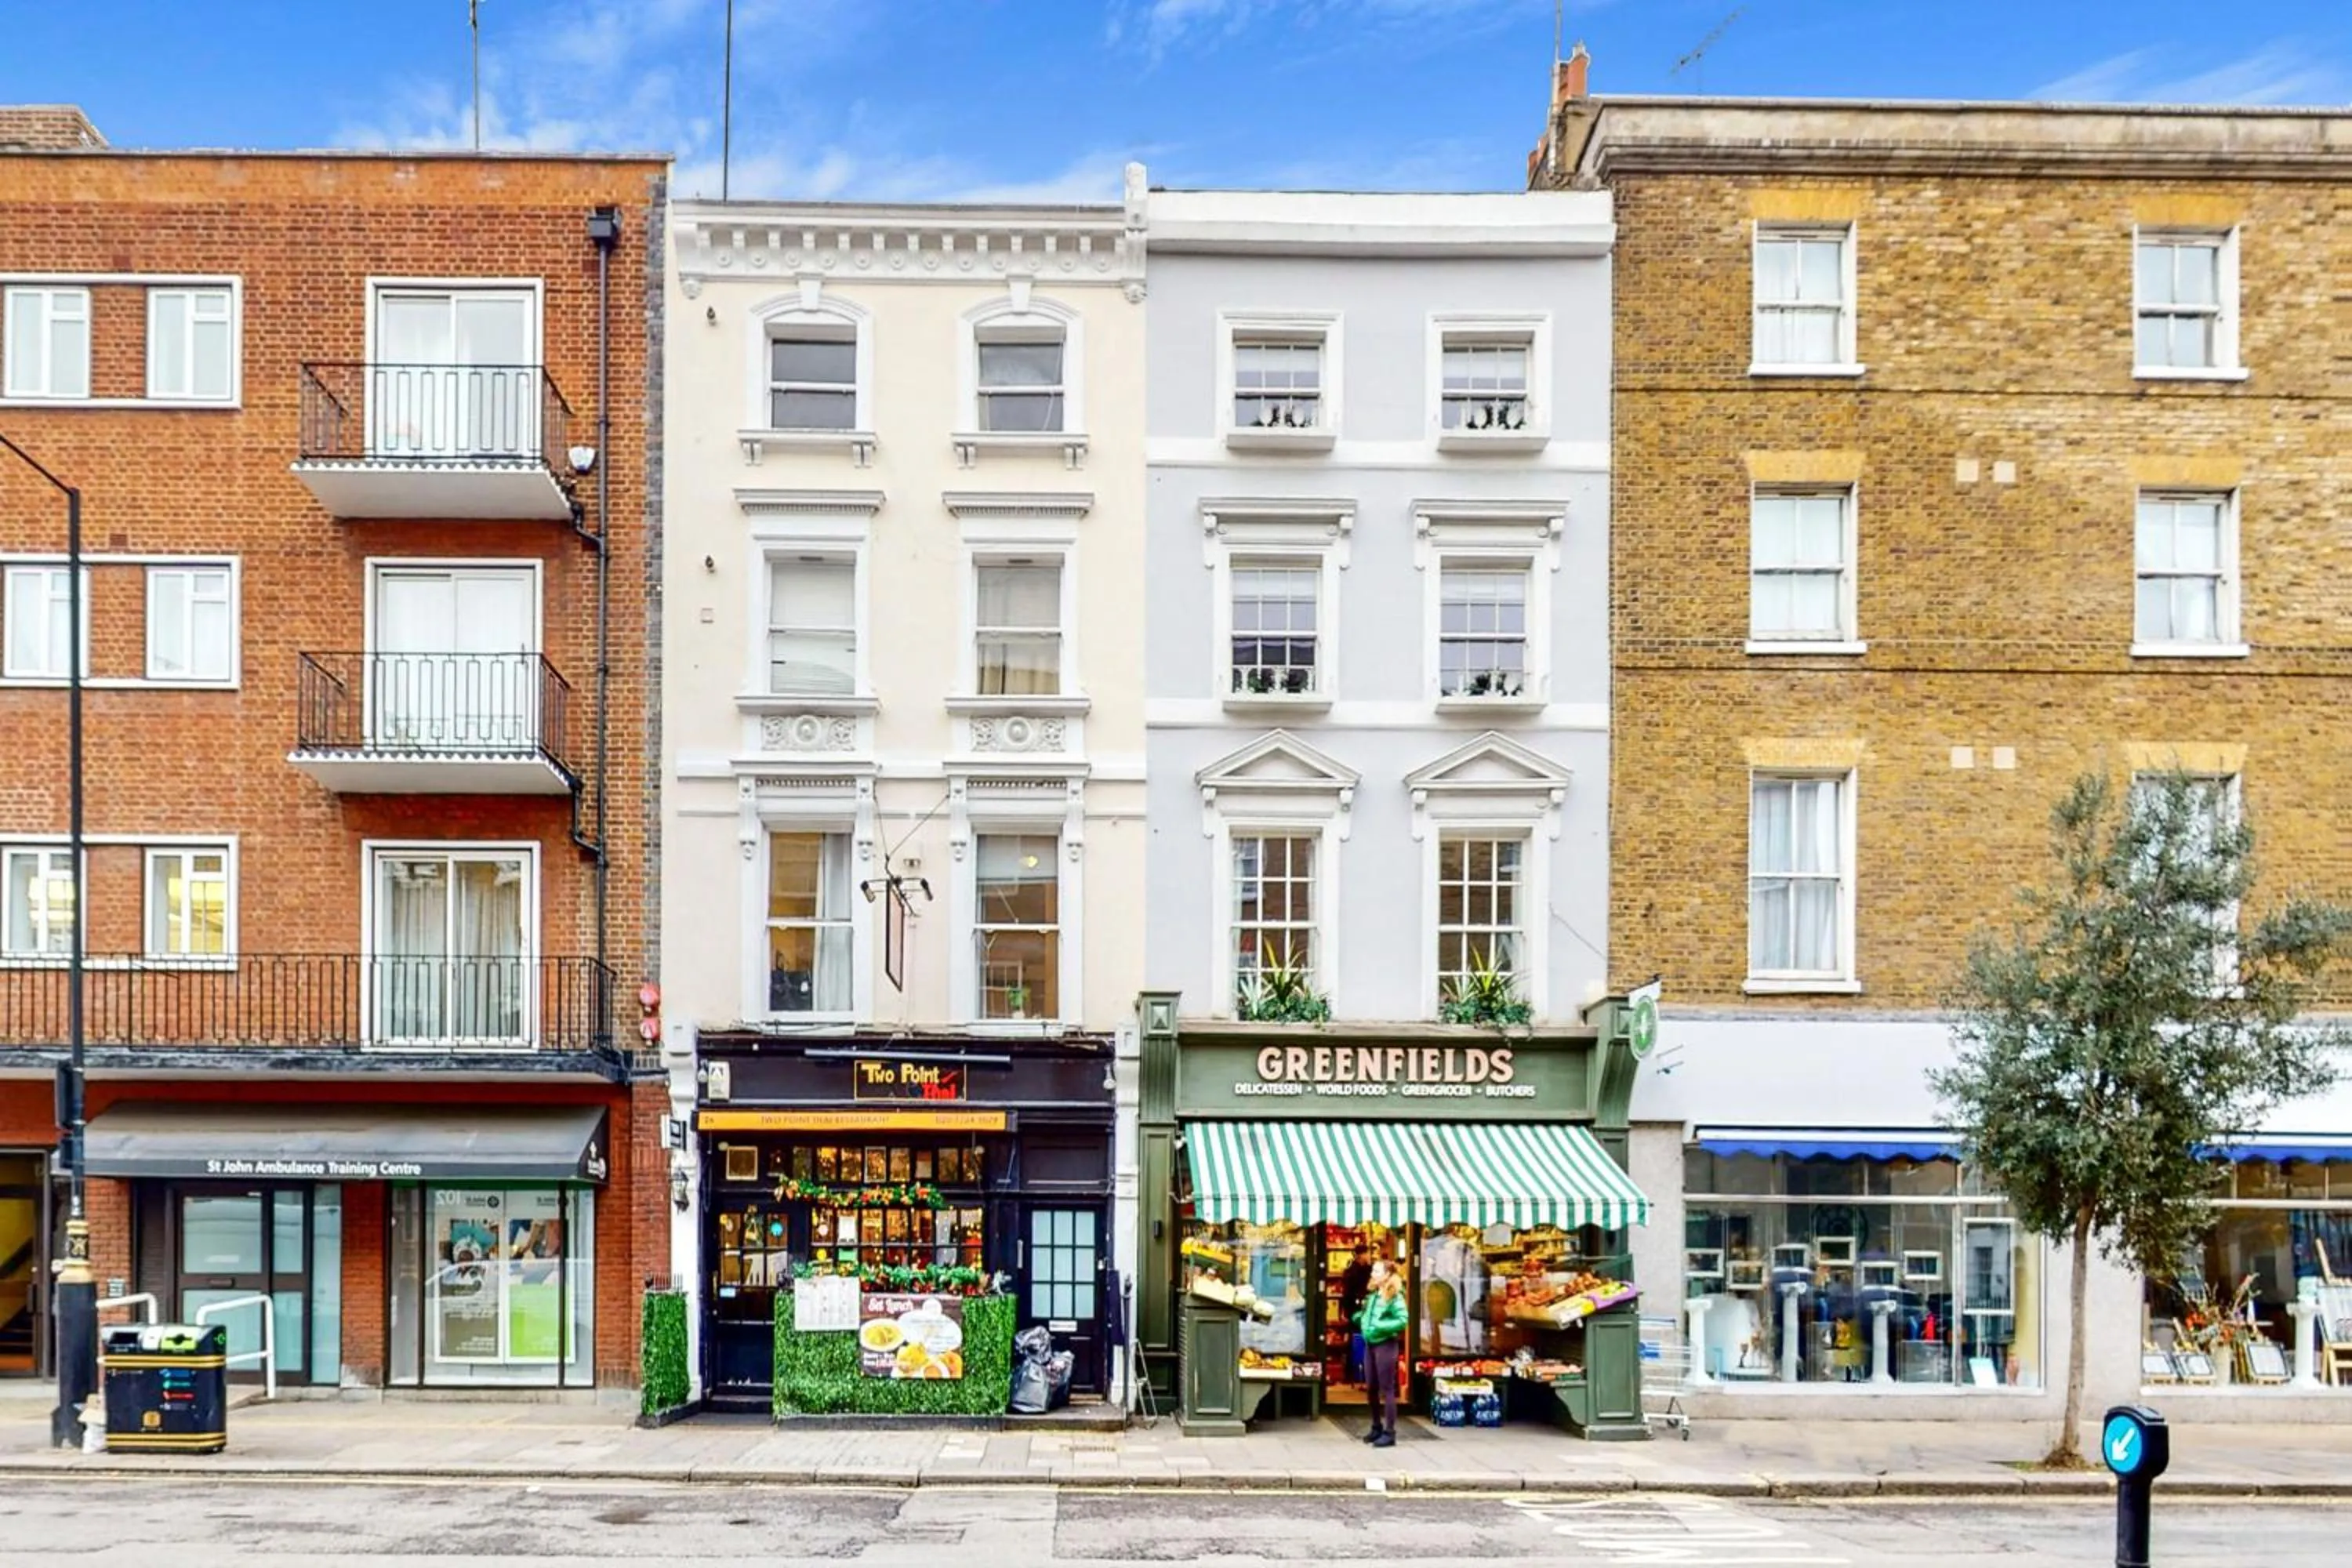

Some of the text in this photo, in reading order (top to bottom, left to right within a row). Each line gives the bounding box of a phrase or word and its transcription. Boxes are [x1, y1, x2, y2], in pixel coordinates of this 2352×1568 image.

[861, 1062, 940, 1083] Two Point
[1257, 1047, 1515, 1083] GREENFIELDS
[1235, 1083, 1535, 1096] DELICATESSEN WORLD FOODS GREENGROCER BUTCHERS
[207, 1161, 422, 1176] St John Ambulance Training Centre
